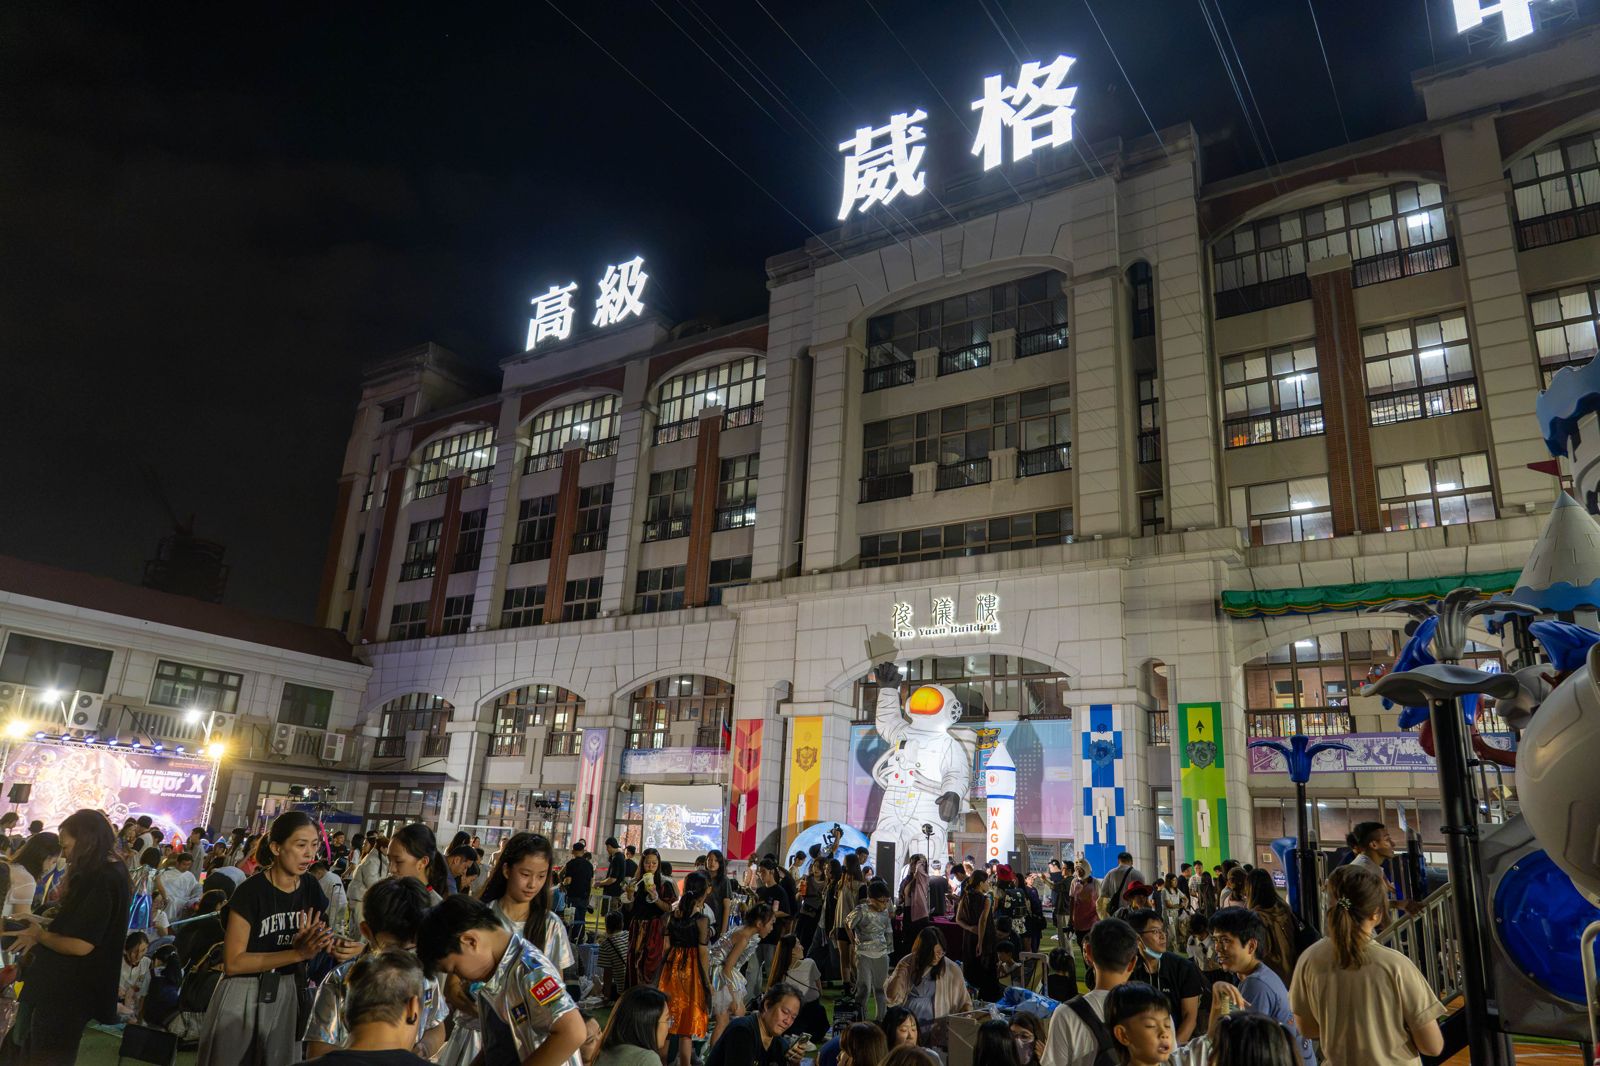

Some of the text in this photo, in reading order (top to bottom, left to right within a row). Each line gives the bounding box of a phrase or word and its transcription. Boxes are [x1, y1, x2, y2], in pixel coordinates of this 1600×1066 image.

[526, 256, 648, 351] 高級
[892, 622, 998, 639] The Yuan Building
[121, 767, 207, 795] Wagor X
[259, 911, 311, 938] NEW YOR
